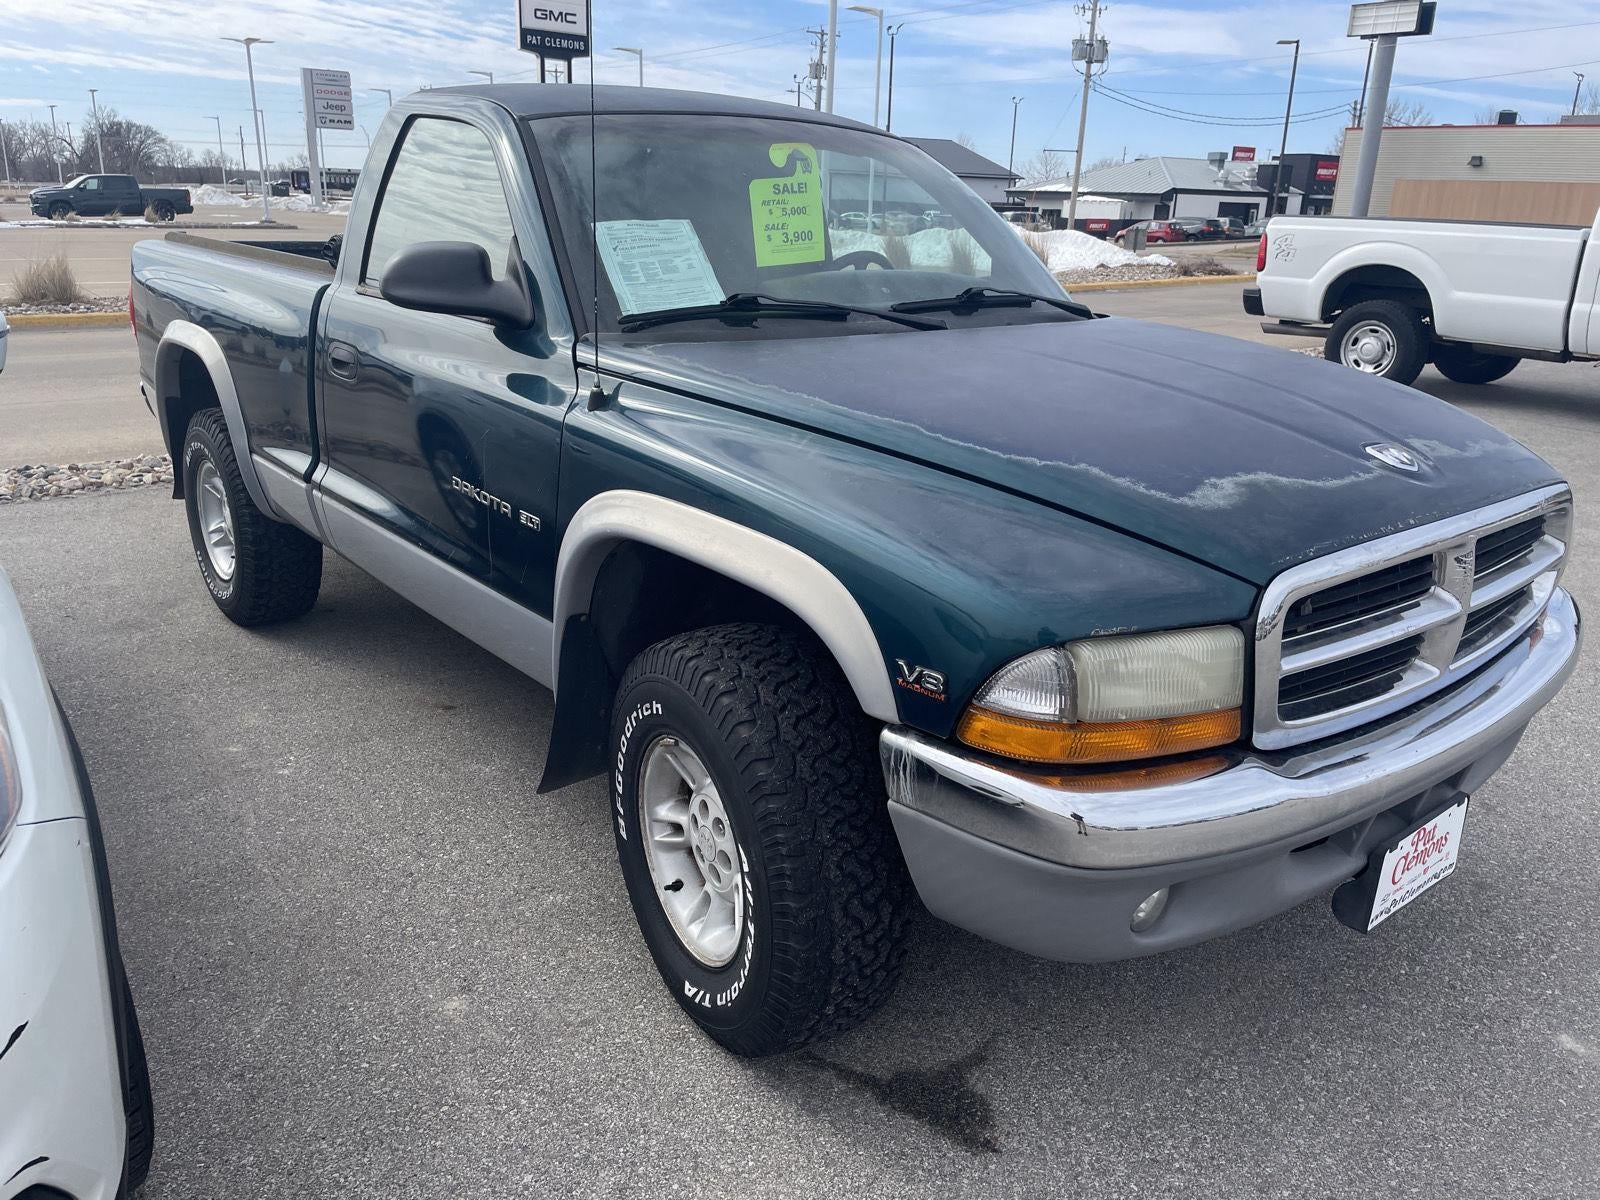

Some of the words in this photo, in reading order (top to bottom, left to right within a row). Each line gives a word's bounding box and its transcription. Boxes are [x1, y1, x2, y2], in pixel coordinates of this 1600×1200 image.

[534, 8, 577, 24] GMC
[526, 34, 541, 45] PAT
[545, 37, 585, 50] CLEMONS
[316, 88, 350, 97] DODGE
[322, 101, 346, 112] Jeep
[772, 182, 807, 195] SALE!
[761, 199, 789, 207] RETAIL:
[781, 206, 807, 218] 5,000
[764, 222, 788, 231] SALE:
[782, 230, 813, 244] 3,900
[452, 475, 512, 519] DAKOTA
[519, 510, 541, 532] SLT
[895, 658, 944, 693] V8
[896, 677, 945, 702] MAGNUM
[615, 700, 662, 840] BFGoodrich
[1410, 823, 1438, 855] Pat
[1391, 832, 1450, 886] Clemons
[684, 980, 712, 1008] T/A
